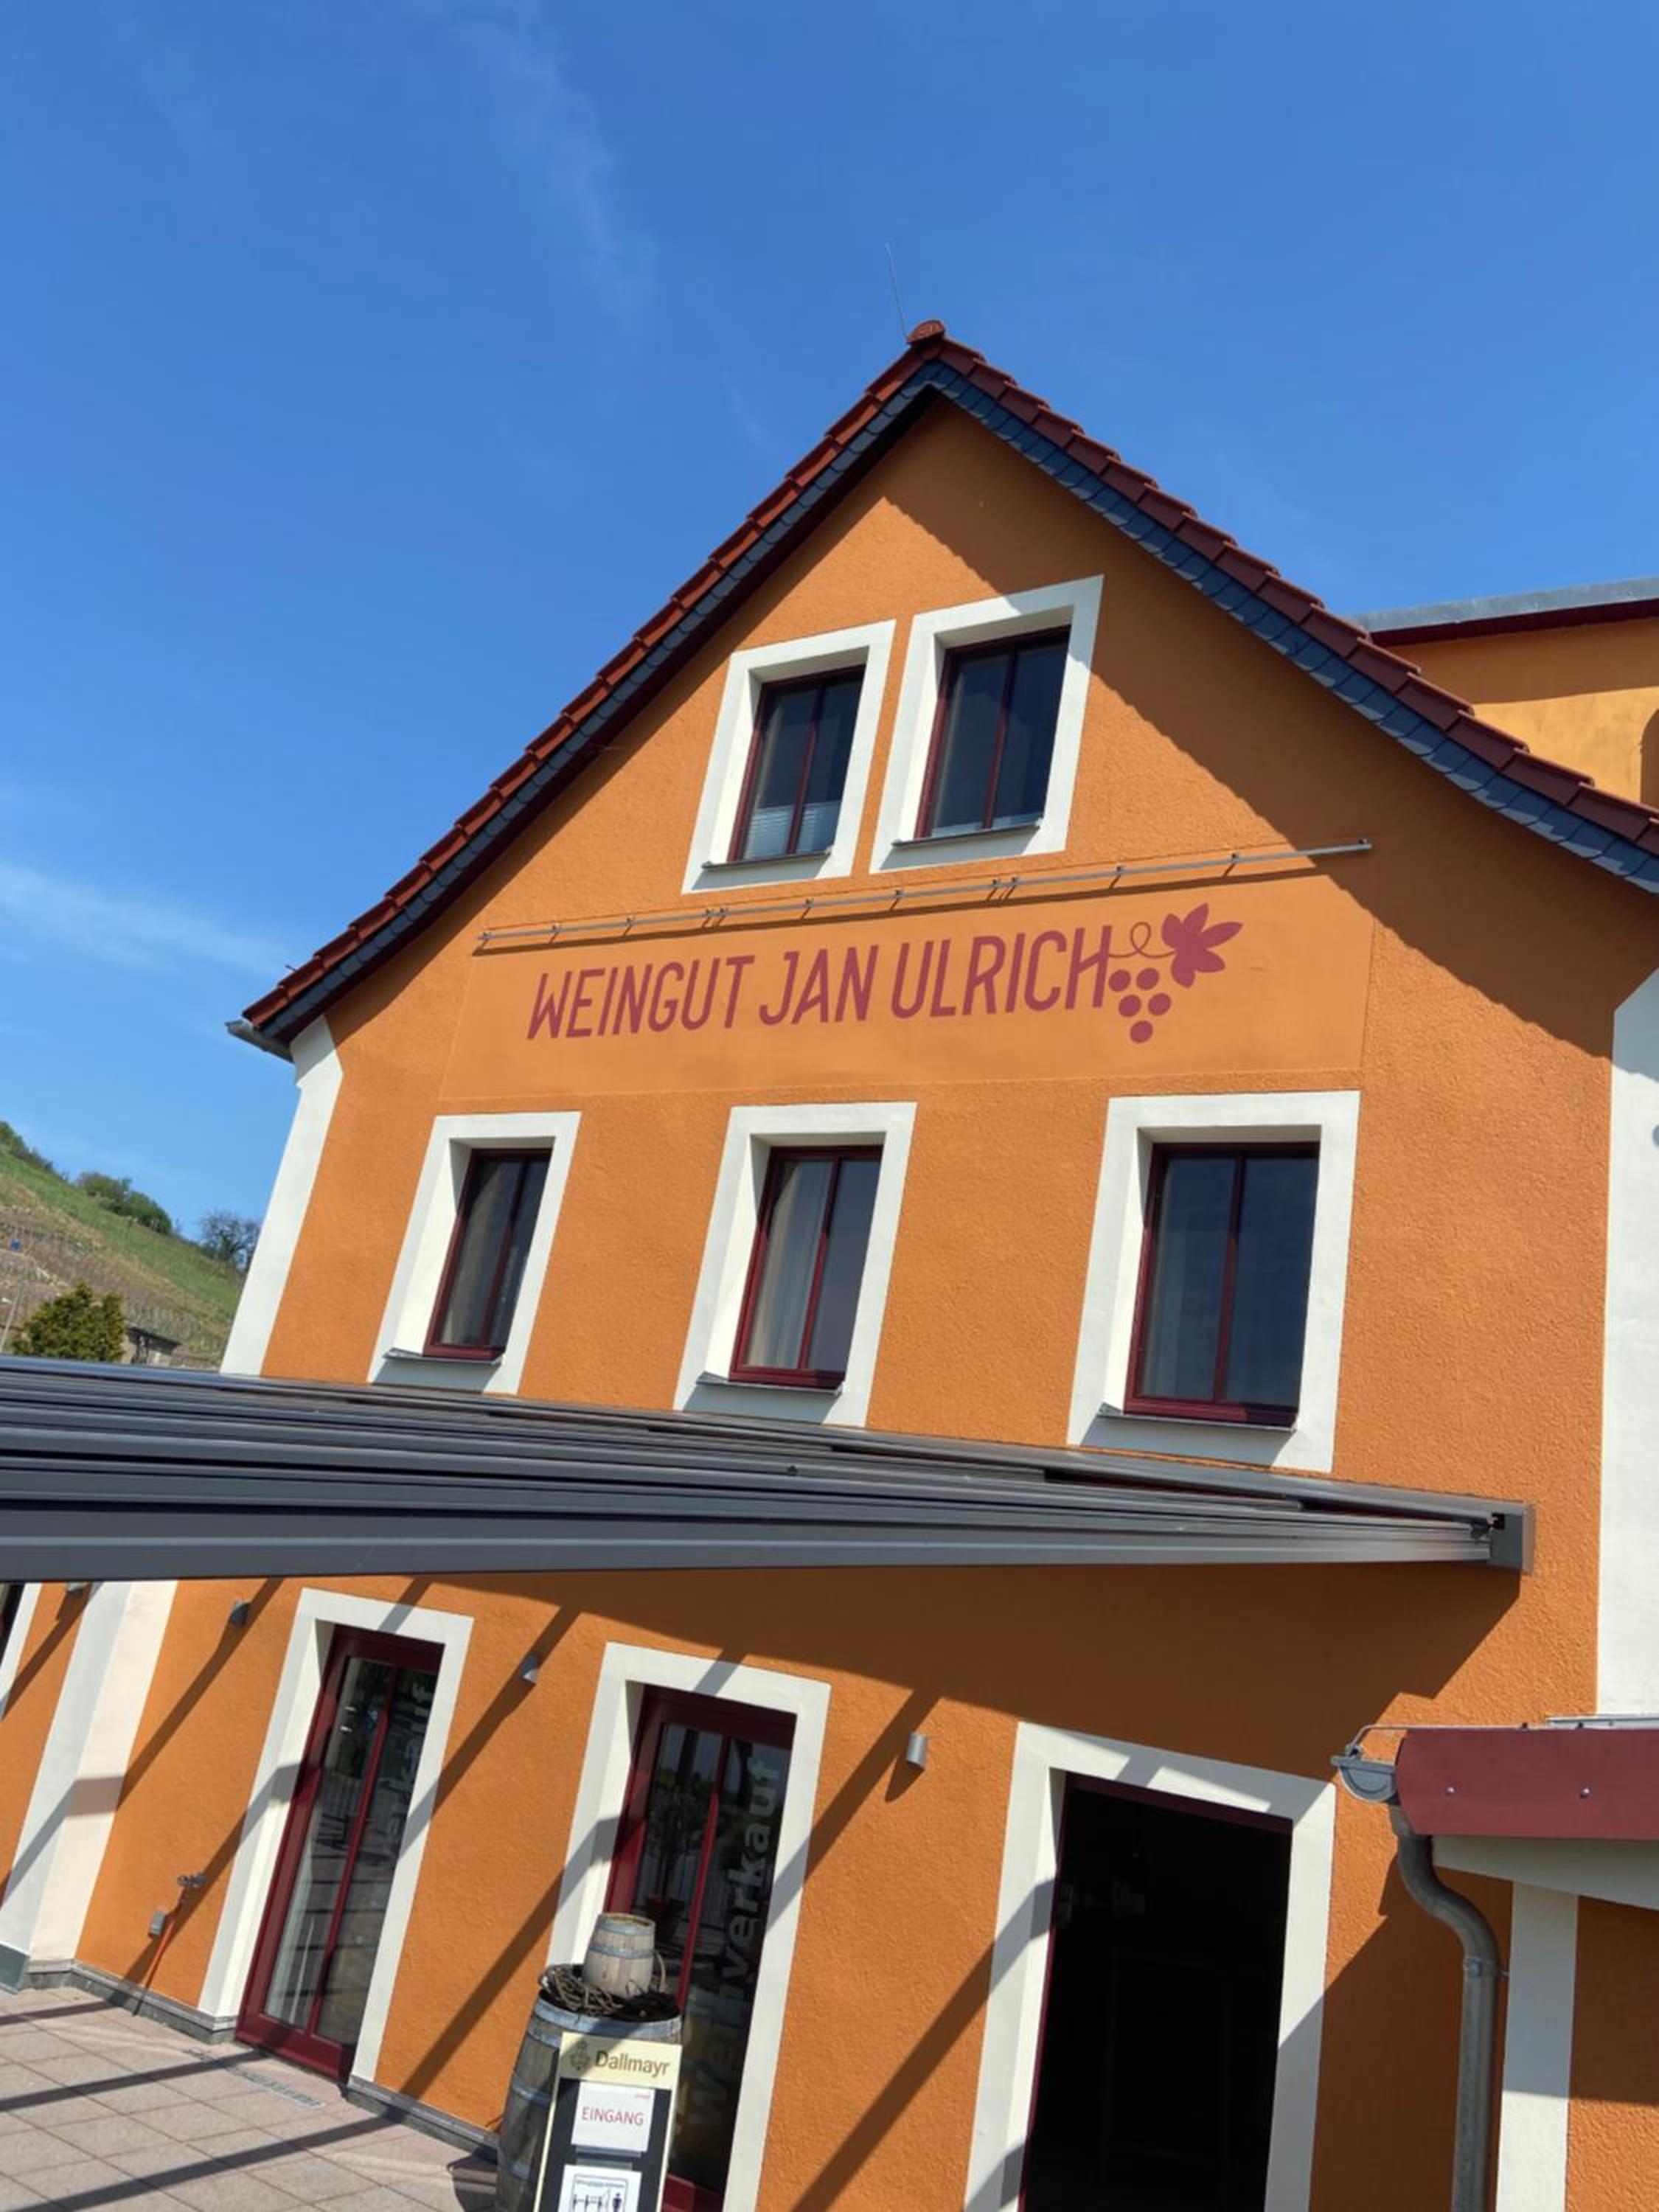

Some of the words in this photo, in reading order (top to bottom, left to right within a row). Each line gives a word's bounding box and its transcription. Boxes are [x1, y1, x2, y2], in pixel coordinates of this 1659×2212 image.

[526, 955, 755, 1040] WEINGUT
[759, 945, 880, 1026] JAN
[891, 925, 1112, 1019] ULRICH
[595, 2050, 671, 2078] Dallmayr
[581, 2106, 644, 2126] EINGANG
